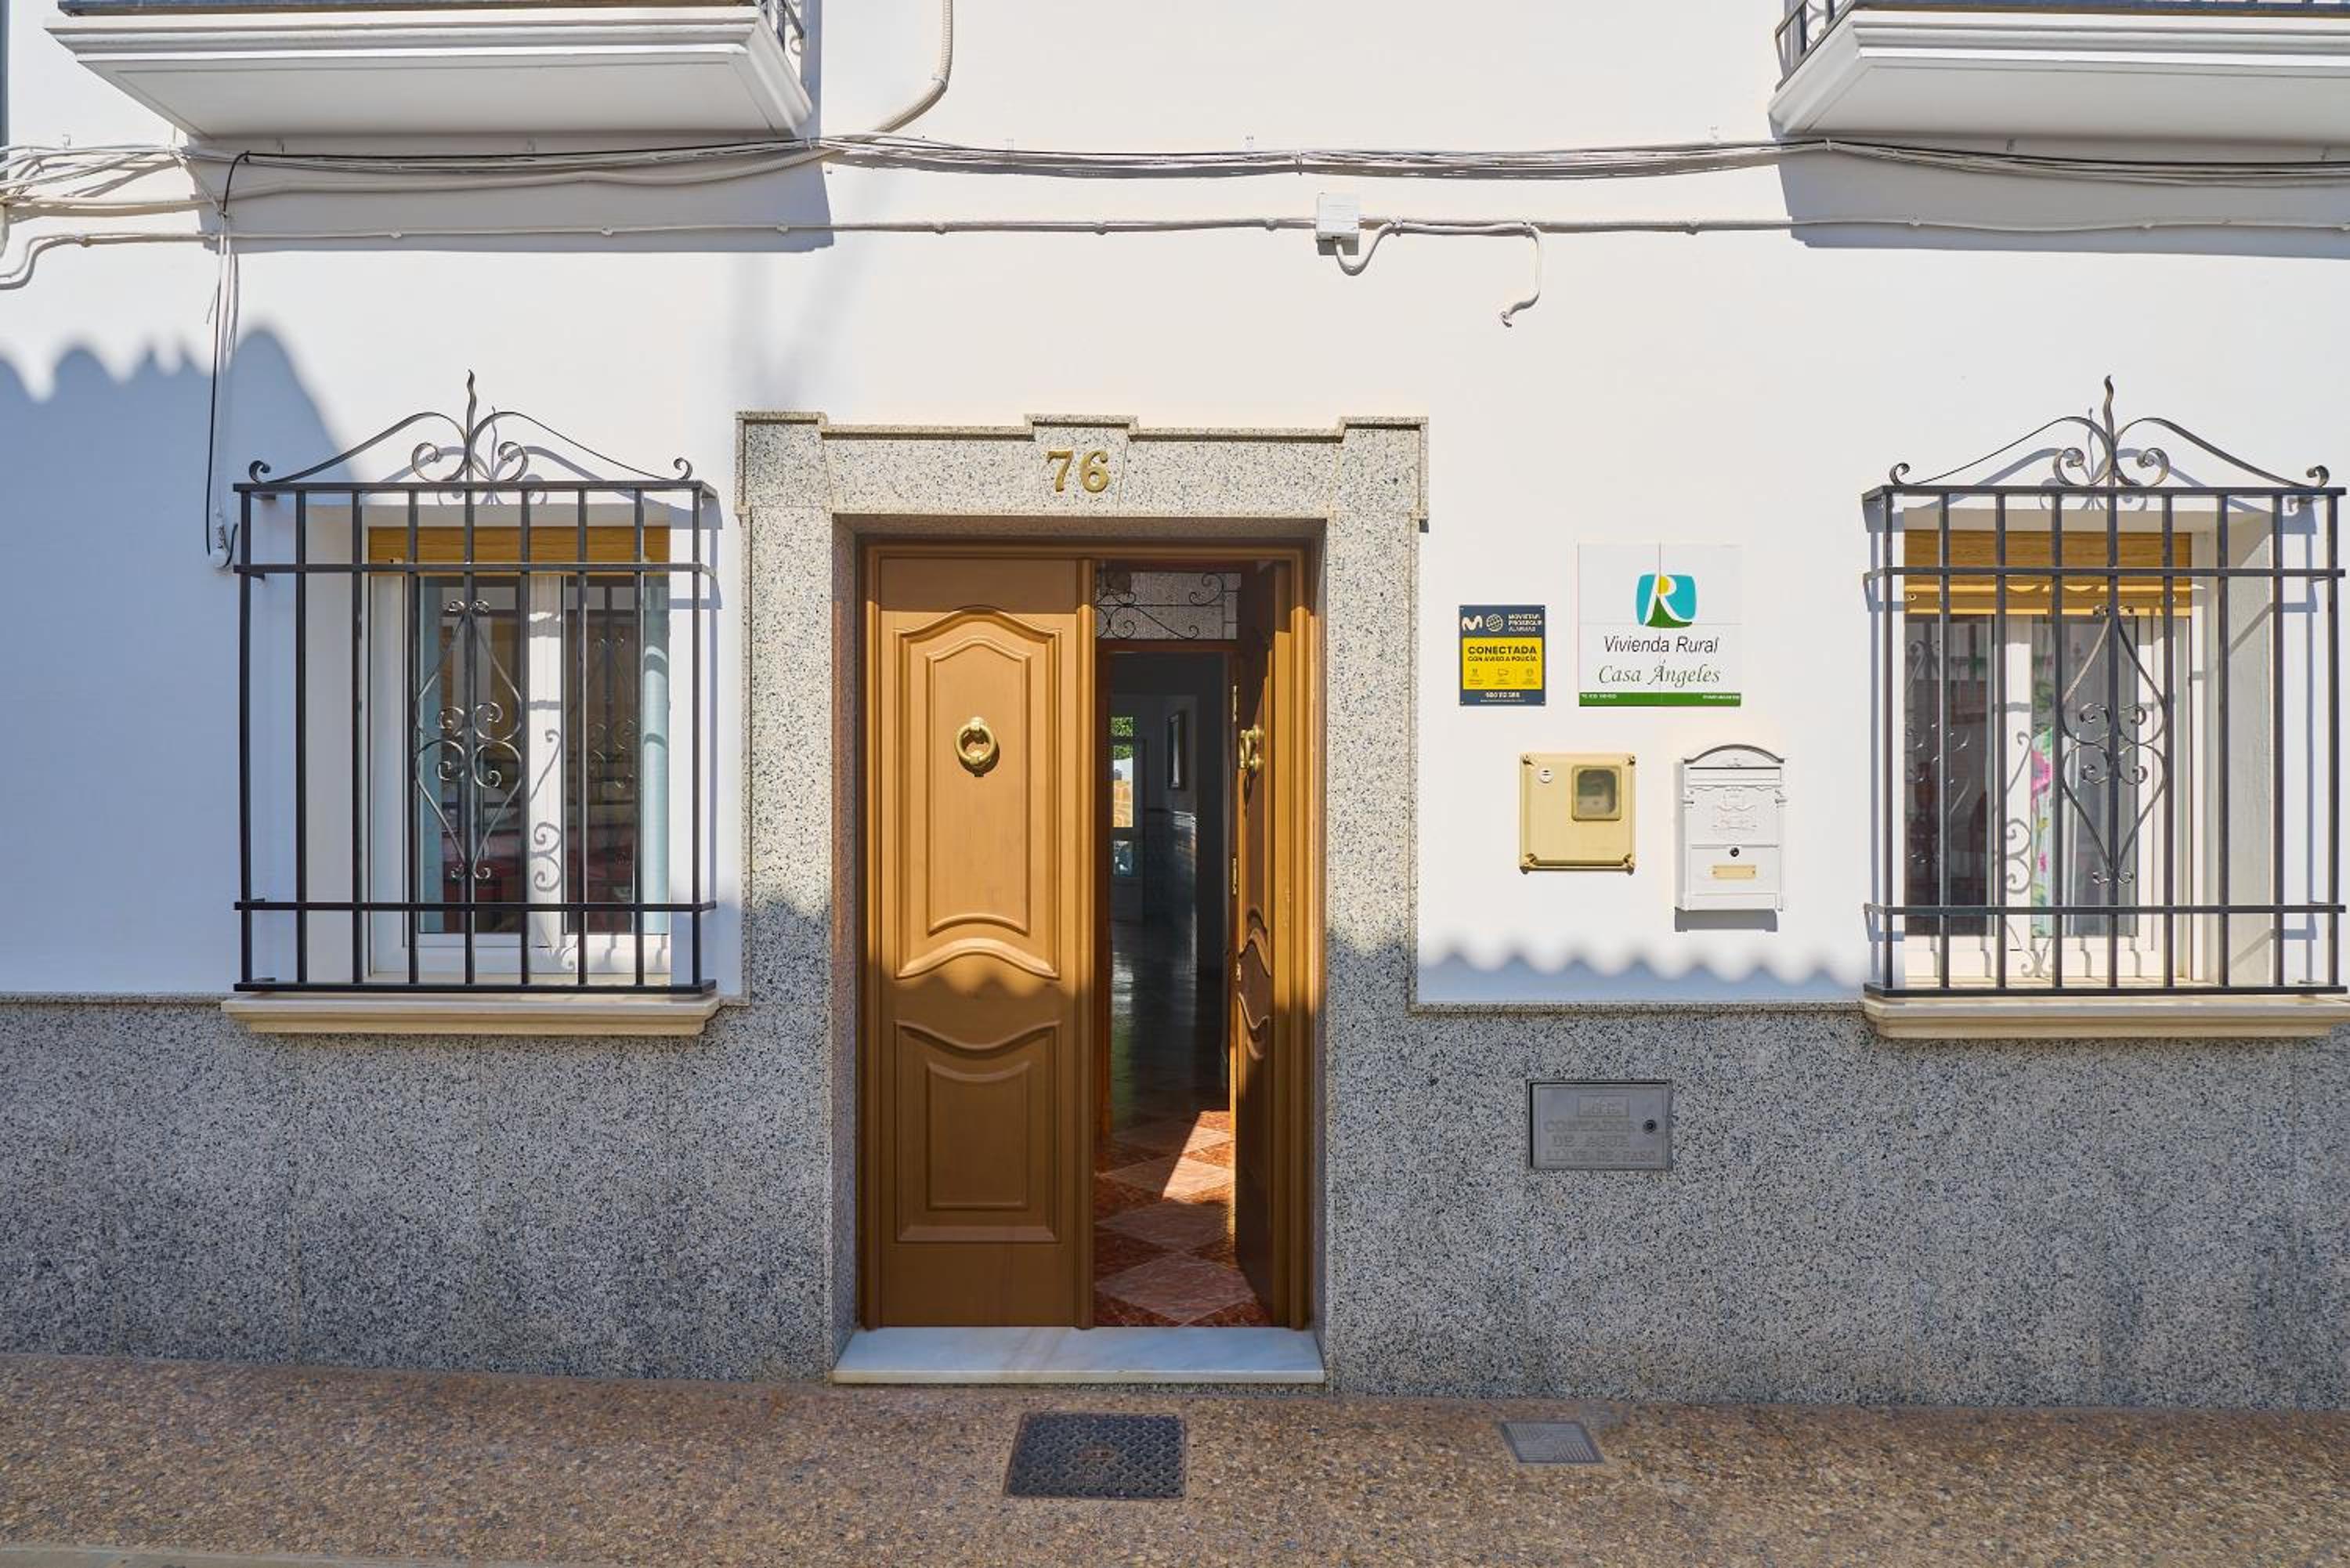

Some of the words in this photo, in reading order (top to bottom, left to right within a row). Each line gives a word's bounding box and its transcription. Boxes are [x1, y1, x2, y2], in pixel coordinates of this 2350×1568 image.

[1047, 450, 1109, 493] 76
[1467, 645, 1537, 655] CONECTADA
[1603, 635, 1669, 652] Vivienda
[1676, 635, 1719, 653] Rural
[1598, 664, 1642, 684] Casa
[1647, 659, 1721, 688] Ángeles
